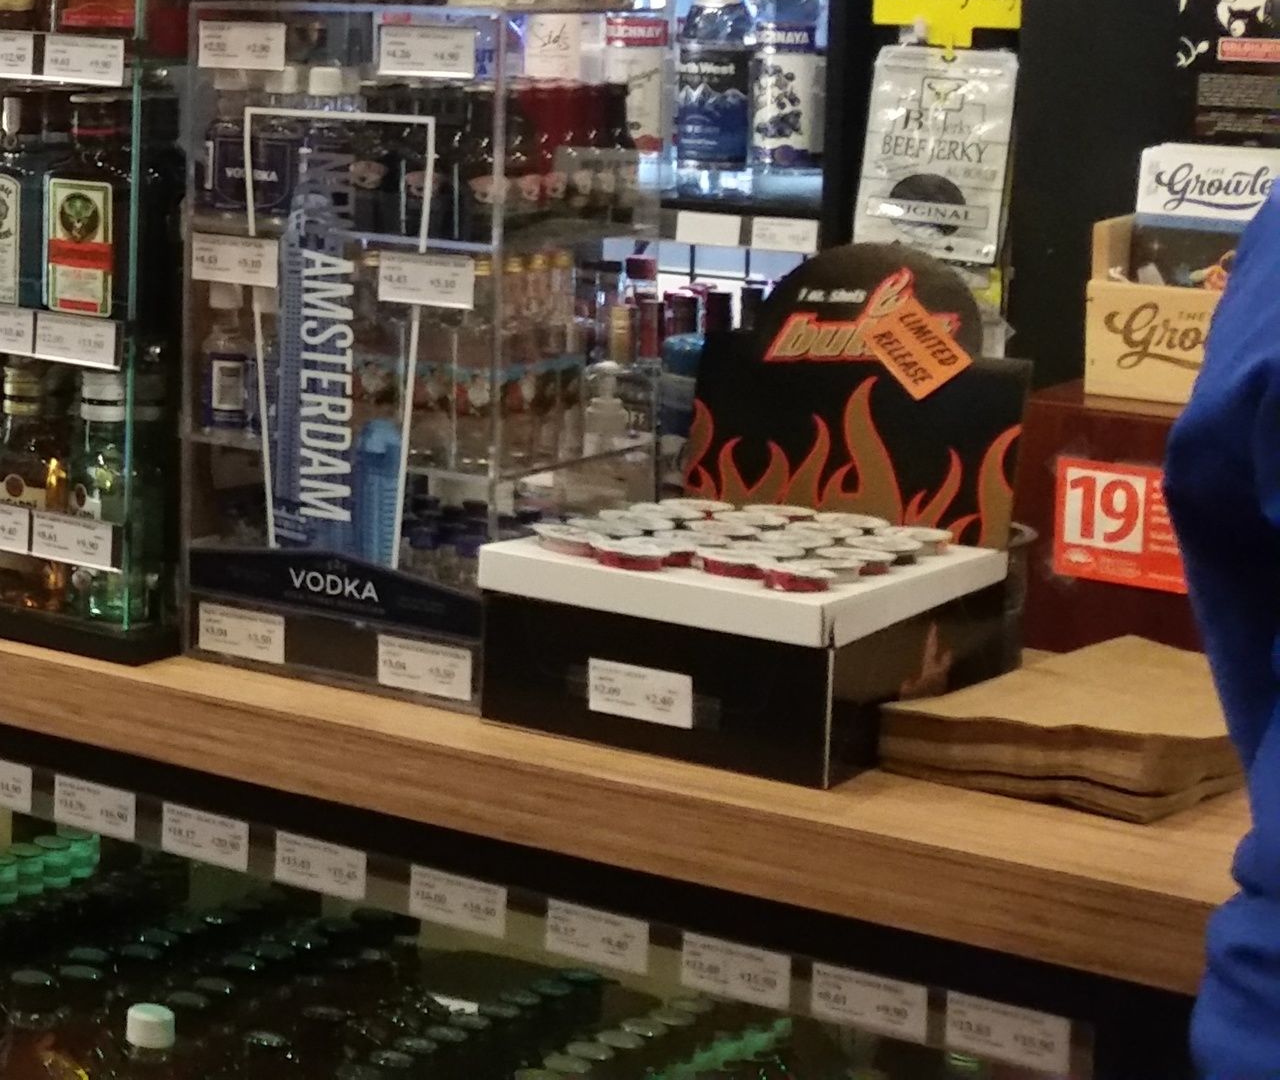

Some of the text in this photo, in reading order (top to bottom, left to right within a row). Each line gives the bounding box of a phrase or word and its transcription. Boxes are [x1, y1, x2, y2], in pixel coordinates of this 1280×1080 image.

[880, 134, 989, 164] BEEF JERKY
[1154, 162, 1274, 211] Growle
[873, 331, 934, 386] RELEASE
[898, 312, 961, 368] LIMITED
[298, 248, 357, 524] AMSTERDAM
[1068, 475, 1141, 547] 19
[288, 566, 380, 604] VODKA
